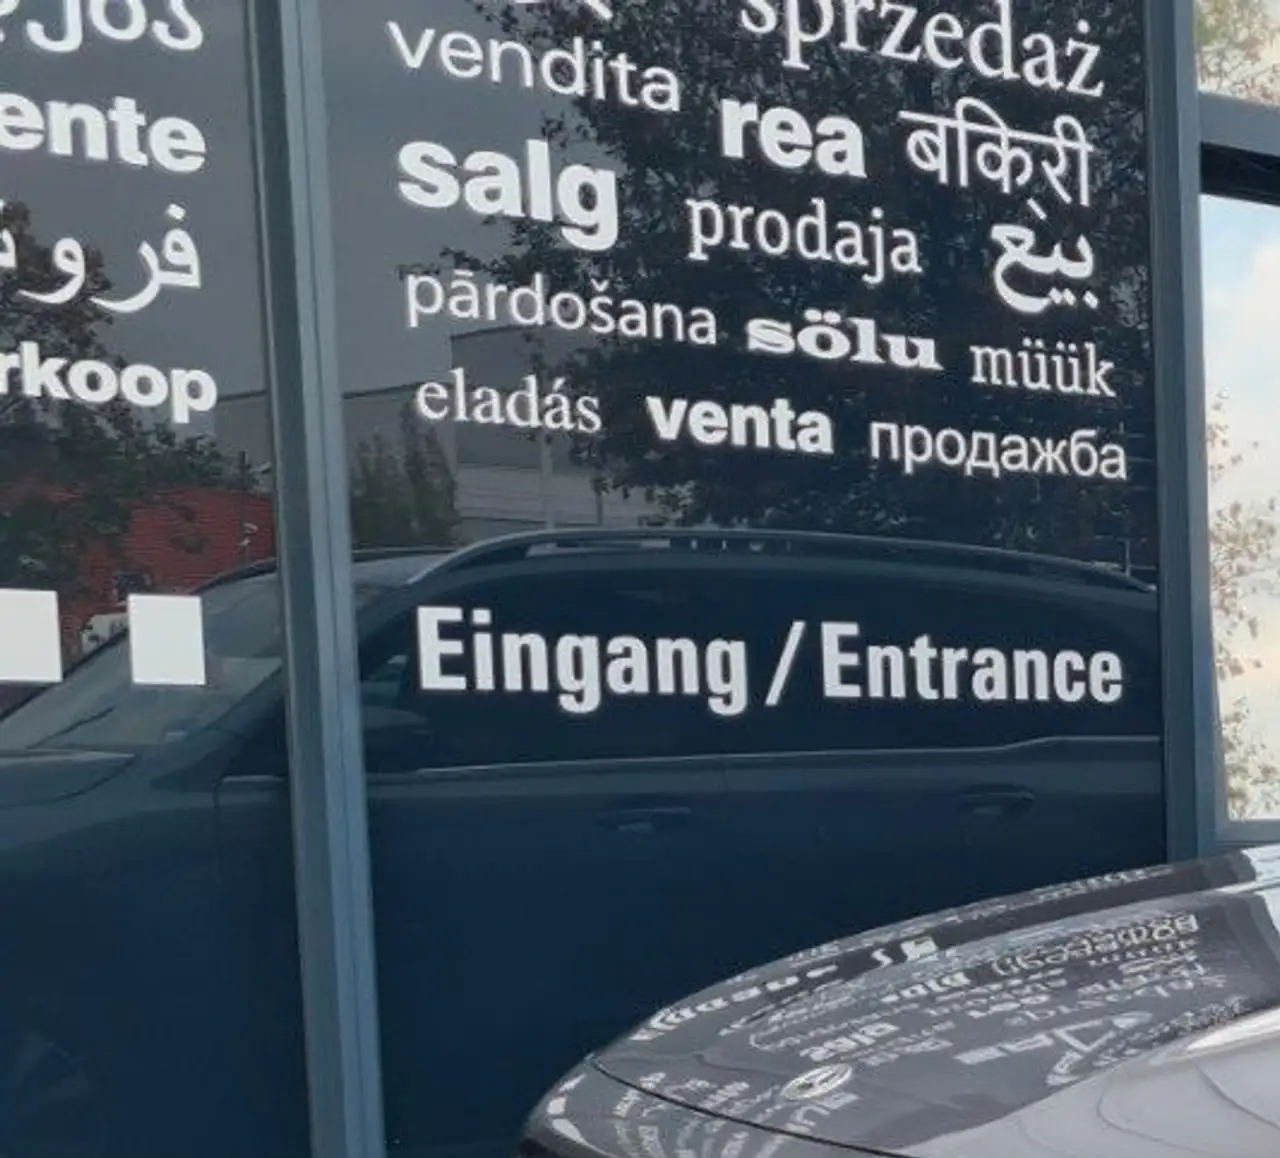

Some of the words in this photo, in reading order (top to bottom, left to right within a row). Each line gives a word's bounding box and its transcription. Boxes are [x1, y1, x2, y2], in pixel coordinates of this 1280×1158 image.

[386, 20, 681, 112] vendita
[741, 0, 1104, 98] sprzedaż
[721, 98, 867, 178] rea
[397, 138, 619, 251] salg
[685, 197, 923, 286] prodaja
[991, 223, 1099, 313] بيع
[405, 268, 718, 346] pārdošana
[746, 308, 944, 371] sölu
[414, 366, 603, 433] eladás
[969, 337, 1117, 397] müük
[645, 396, 834, 454] venta
[870, 421, 1128, 481] продажба
[416, 606, 748, 716] Eingang
[820, 621, 1124, 703] Entrance
